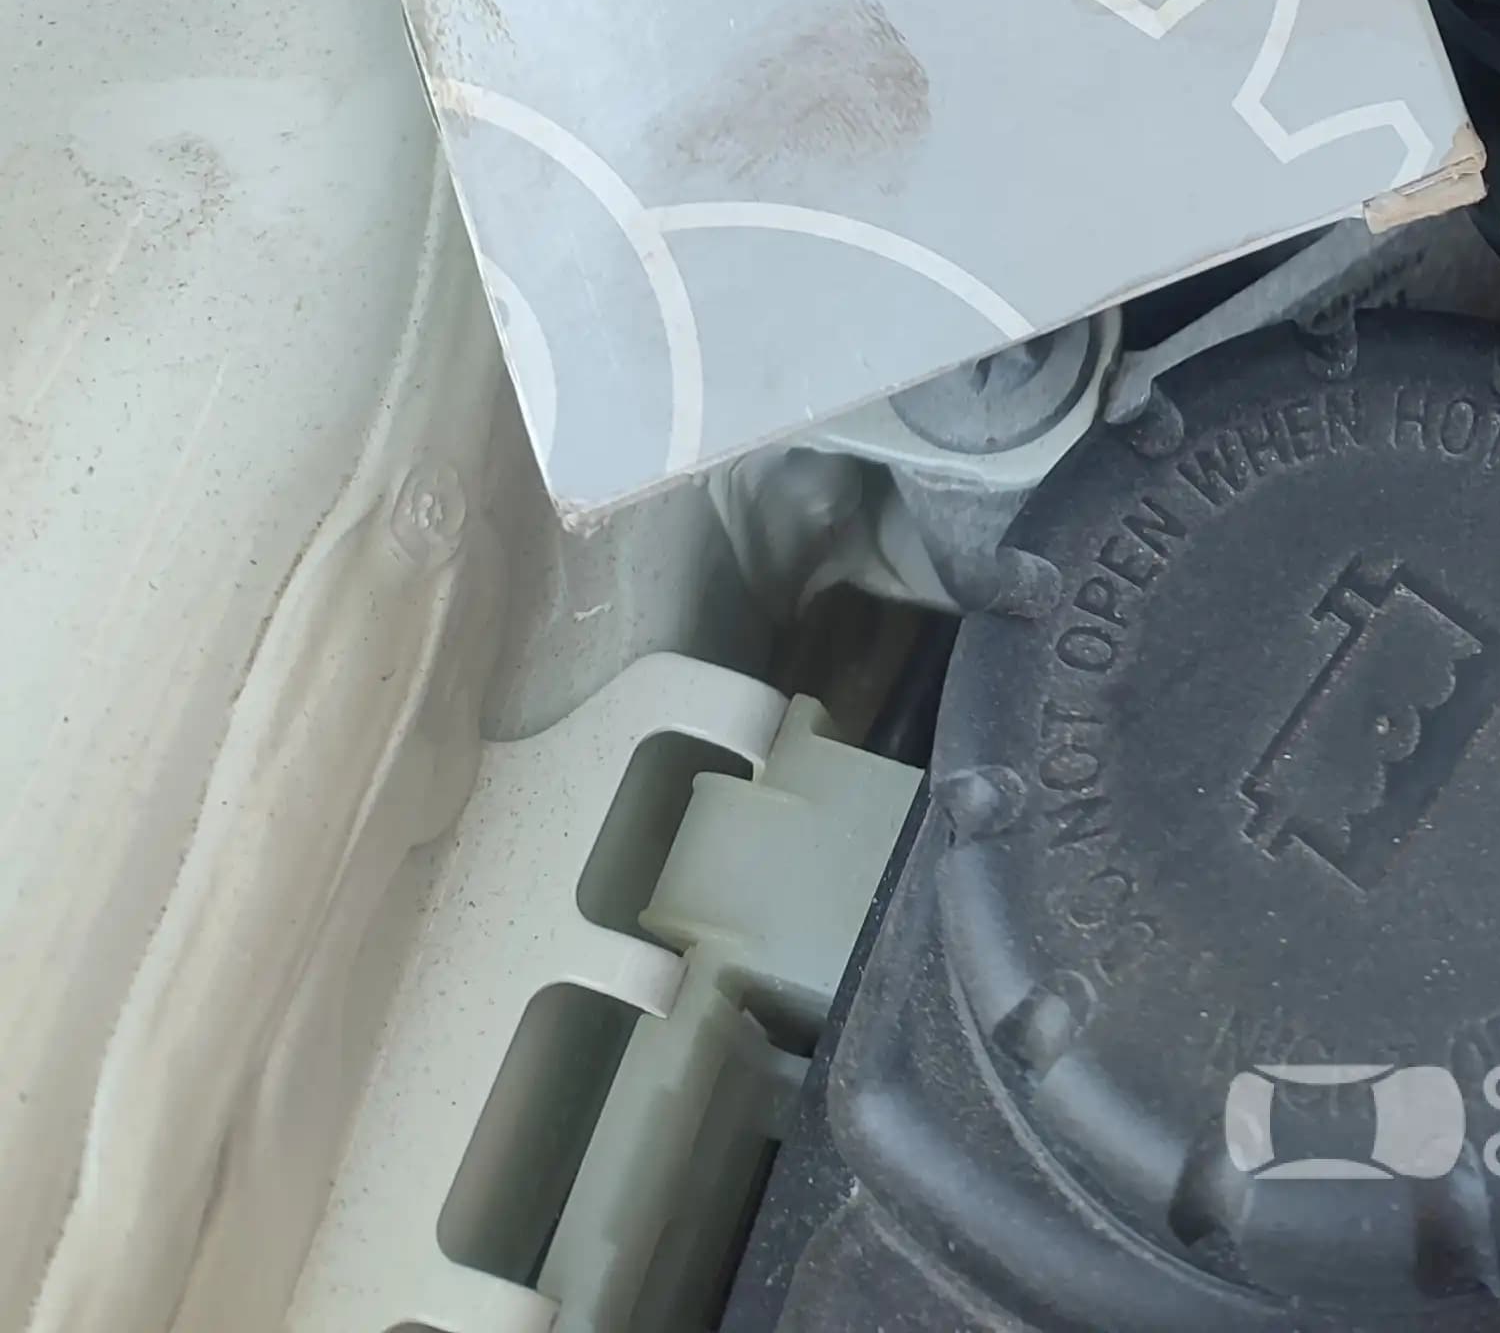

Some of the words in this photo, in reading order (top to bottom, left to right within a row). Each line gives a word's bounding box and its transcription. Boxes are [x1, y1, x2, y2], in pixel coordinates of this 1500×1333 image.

[1176, 388, 1364, 509] WHEN
[1055, 496, 1188, 673] OPEN
[1038, 698, 1112, 851] NOT
